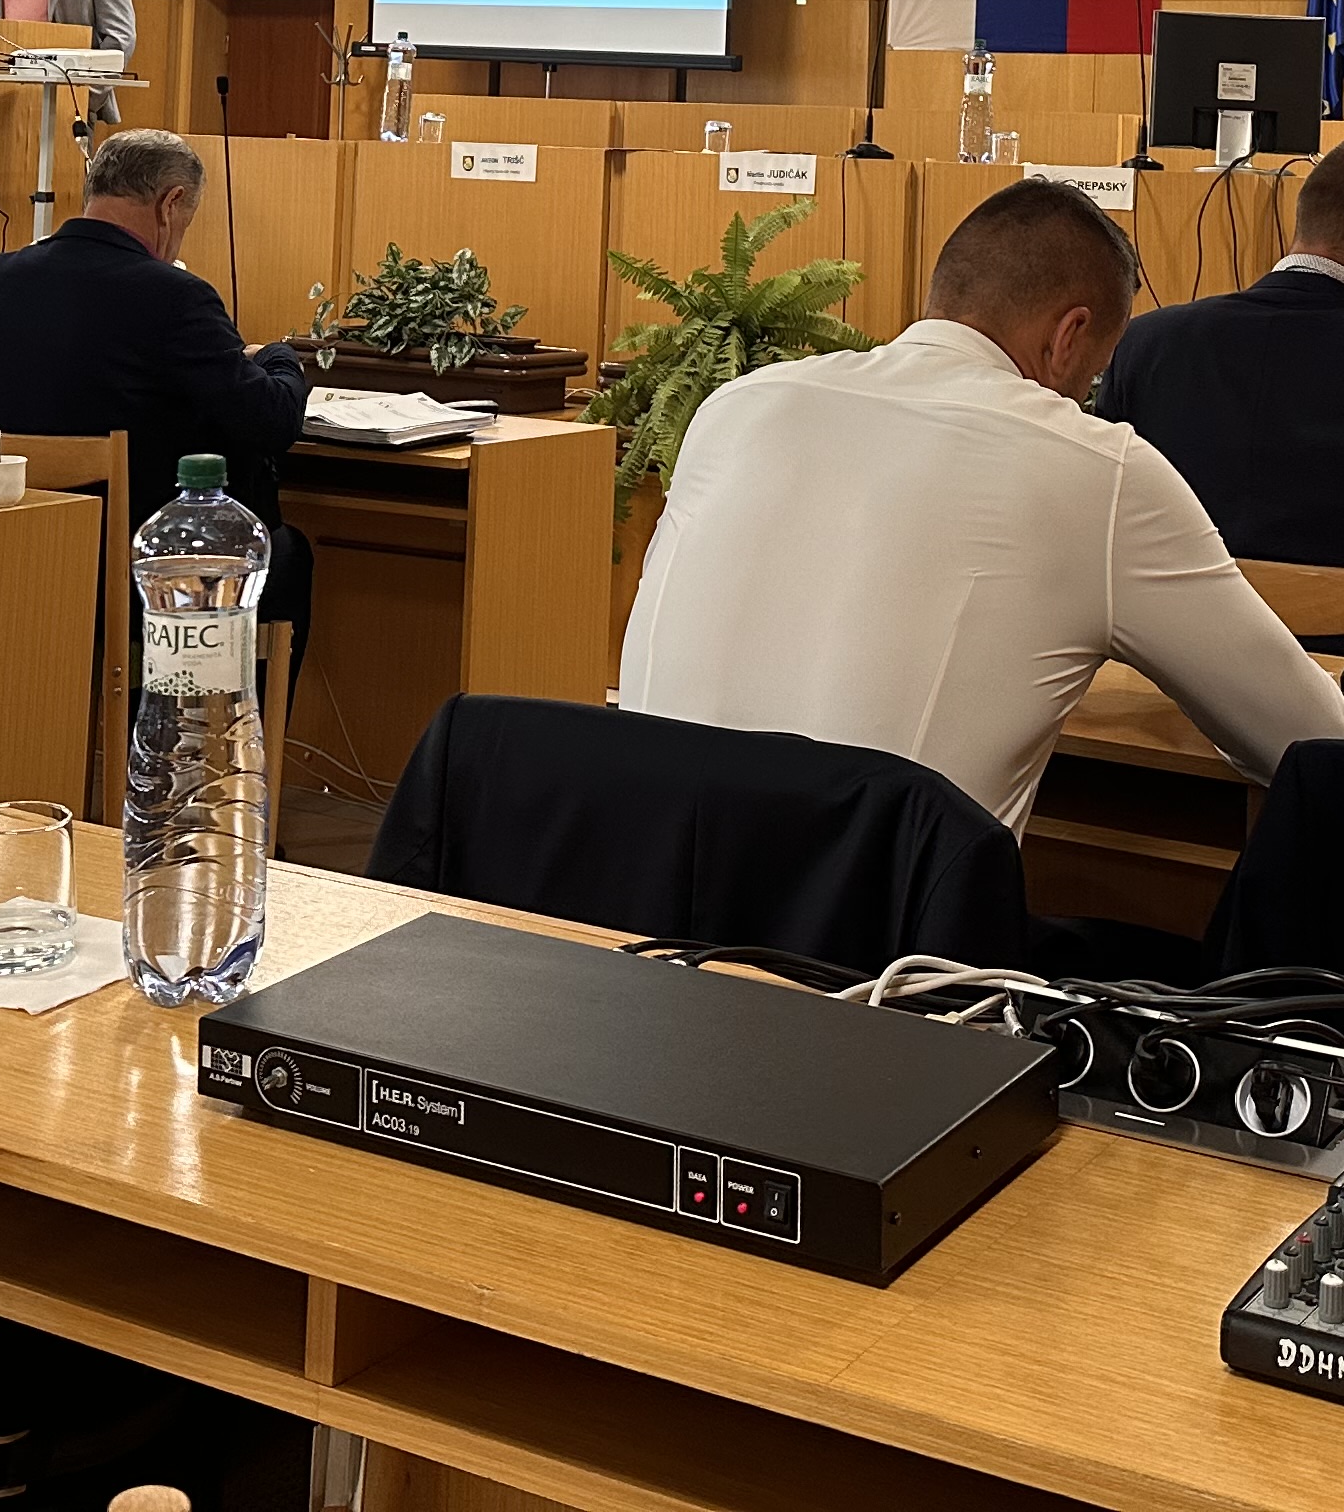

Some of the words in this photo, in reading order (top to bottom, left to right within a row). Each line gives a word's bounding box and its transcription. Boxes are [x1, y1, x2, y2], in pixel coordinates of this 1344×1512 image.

[147, 621, 219, 656] RAJEC
[688, 1171, 708, 1183] DATA
[727, 1180, 755, 1195] POWER
